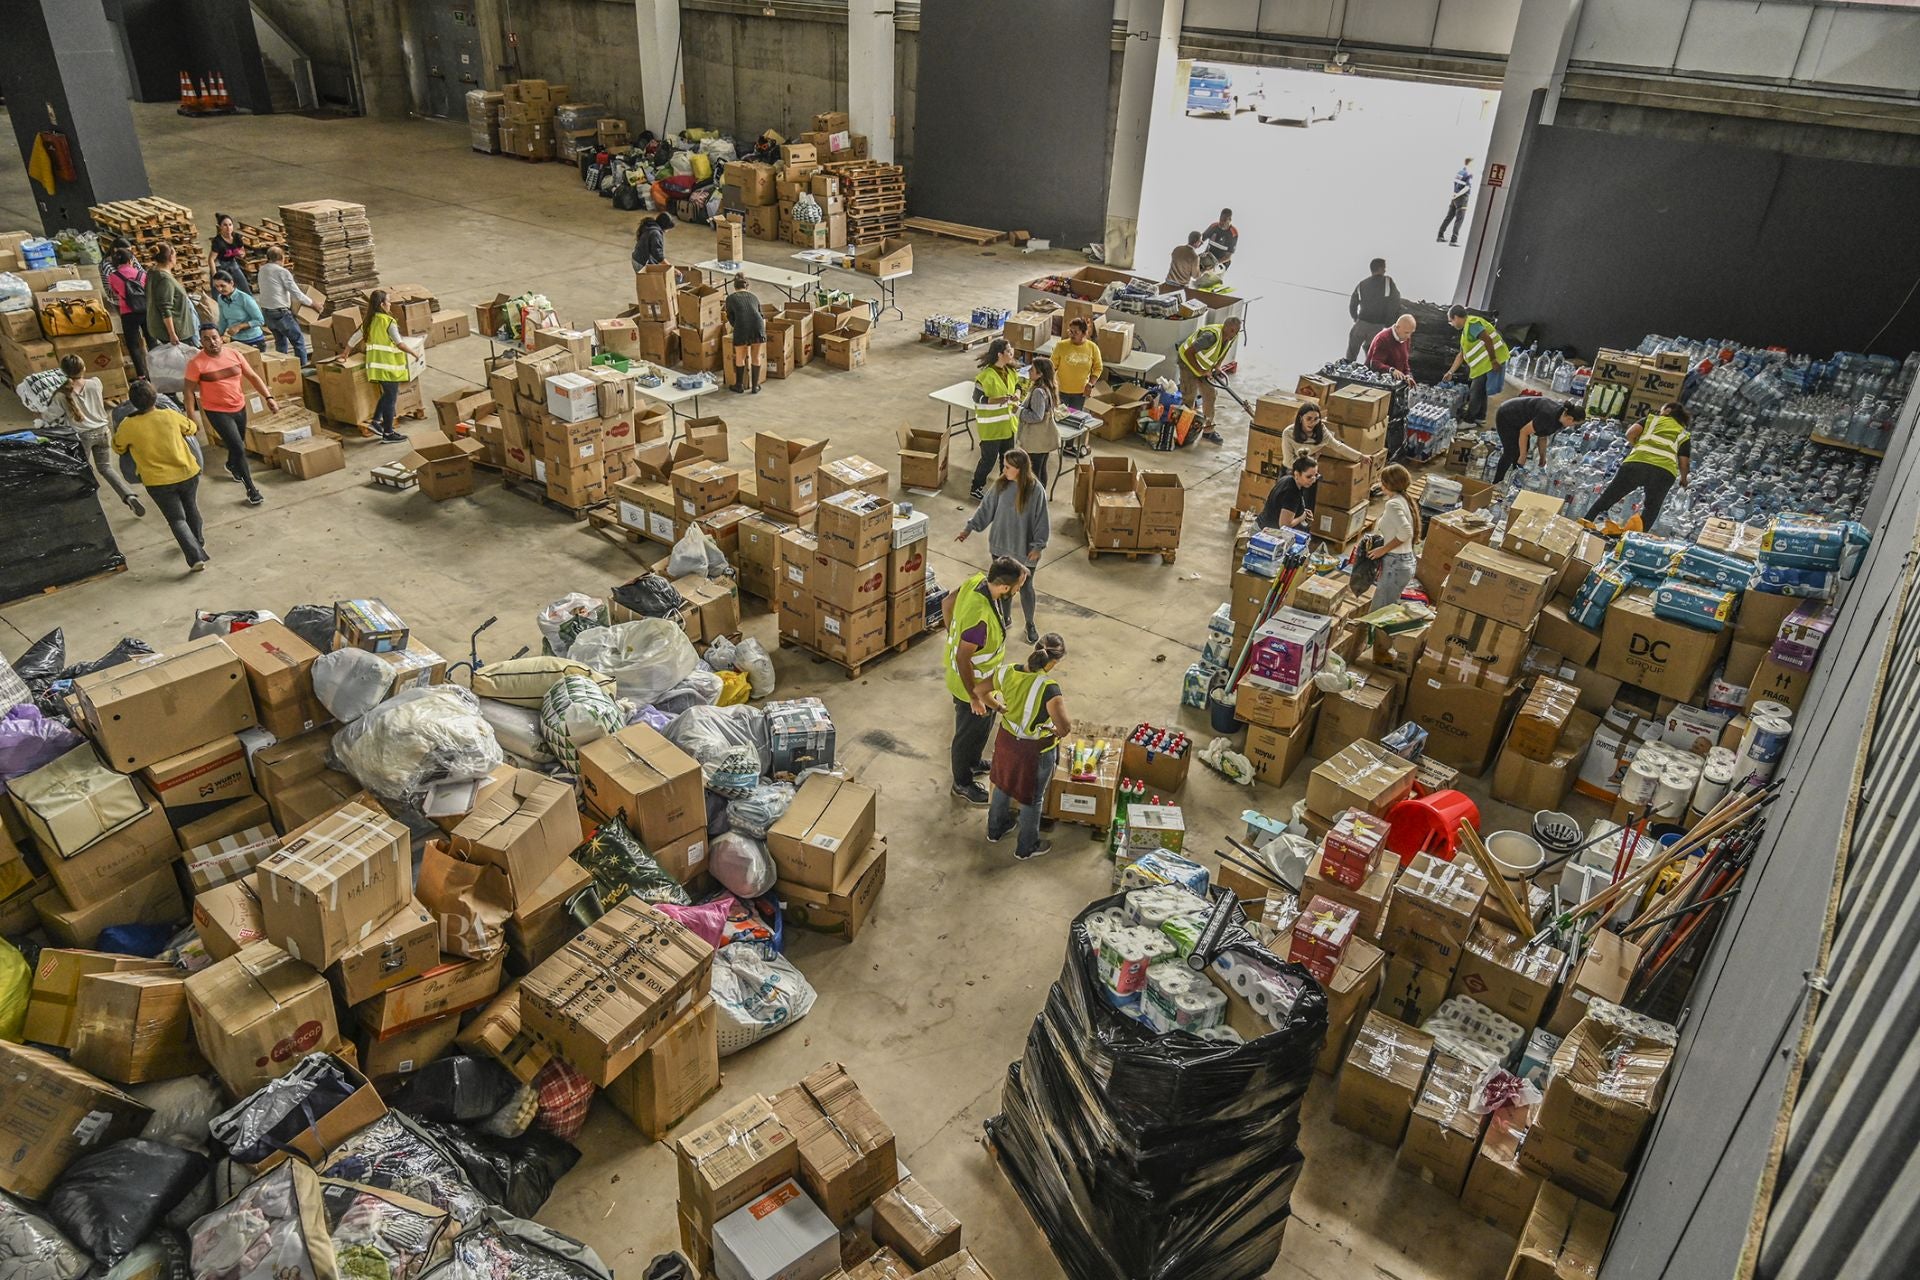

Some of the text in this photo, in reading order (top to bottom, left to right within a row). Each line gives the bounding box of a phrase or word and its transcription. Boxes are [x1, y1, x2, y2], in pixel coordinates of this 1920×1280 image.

[1456, 560, 1473, 571] ABS
[1628, 632, 1671, 664] DC
[1626, 656, 1664, 673] GROUP
[425, 980, 446, 996] Pan
[583, 993, 606, 1014] PUNT
